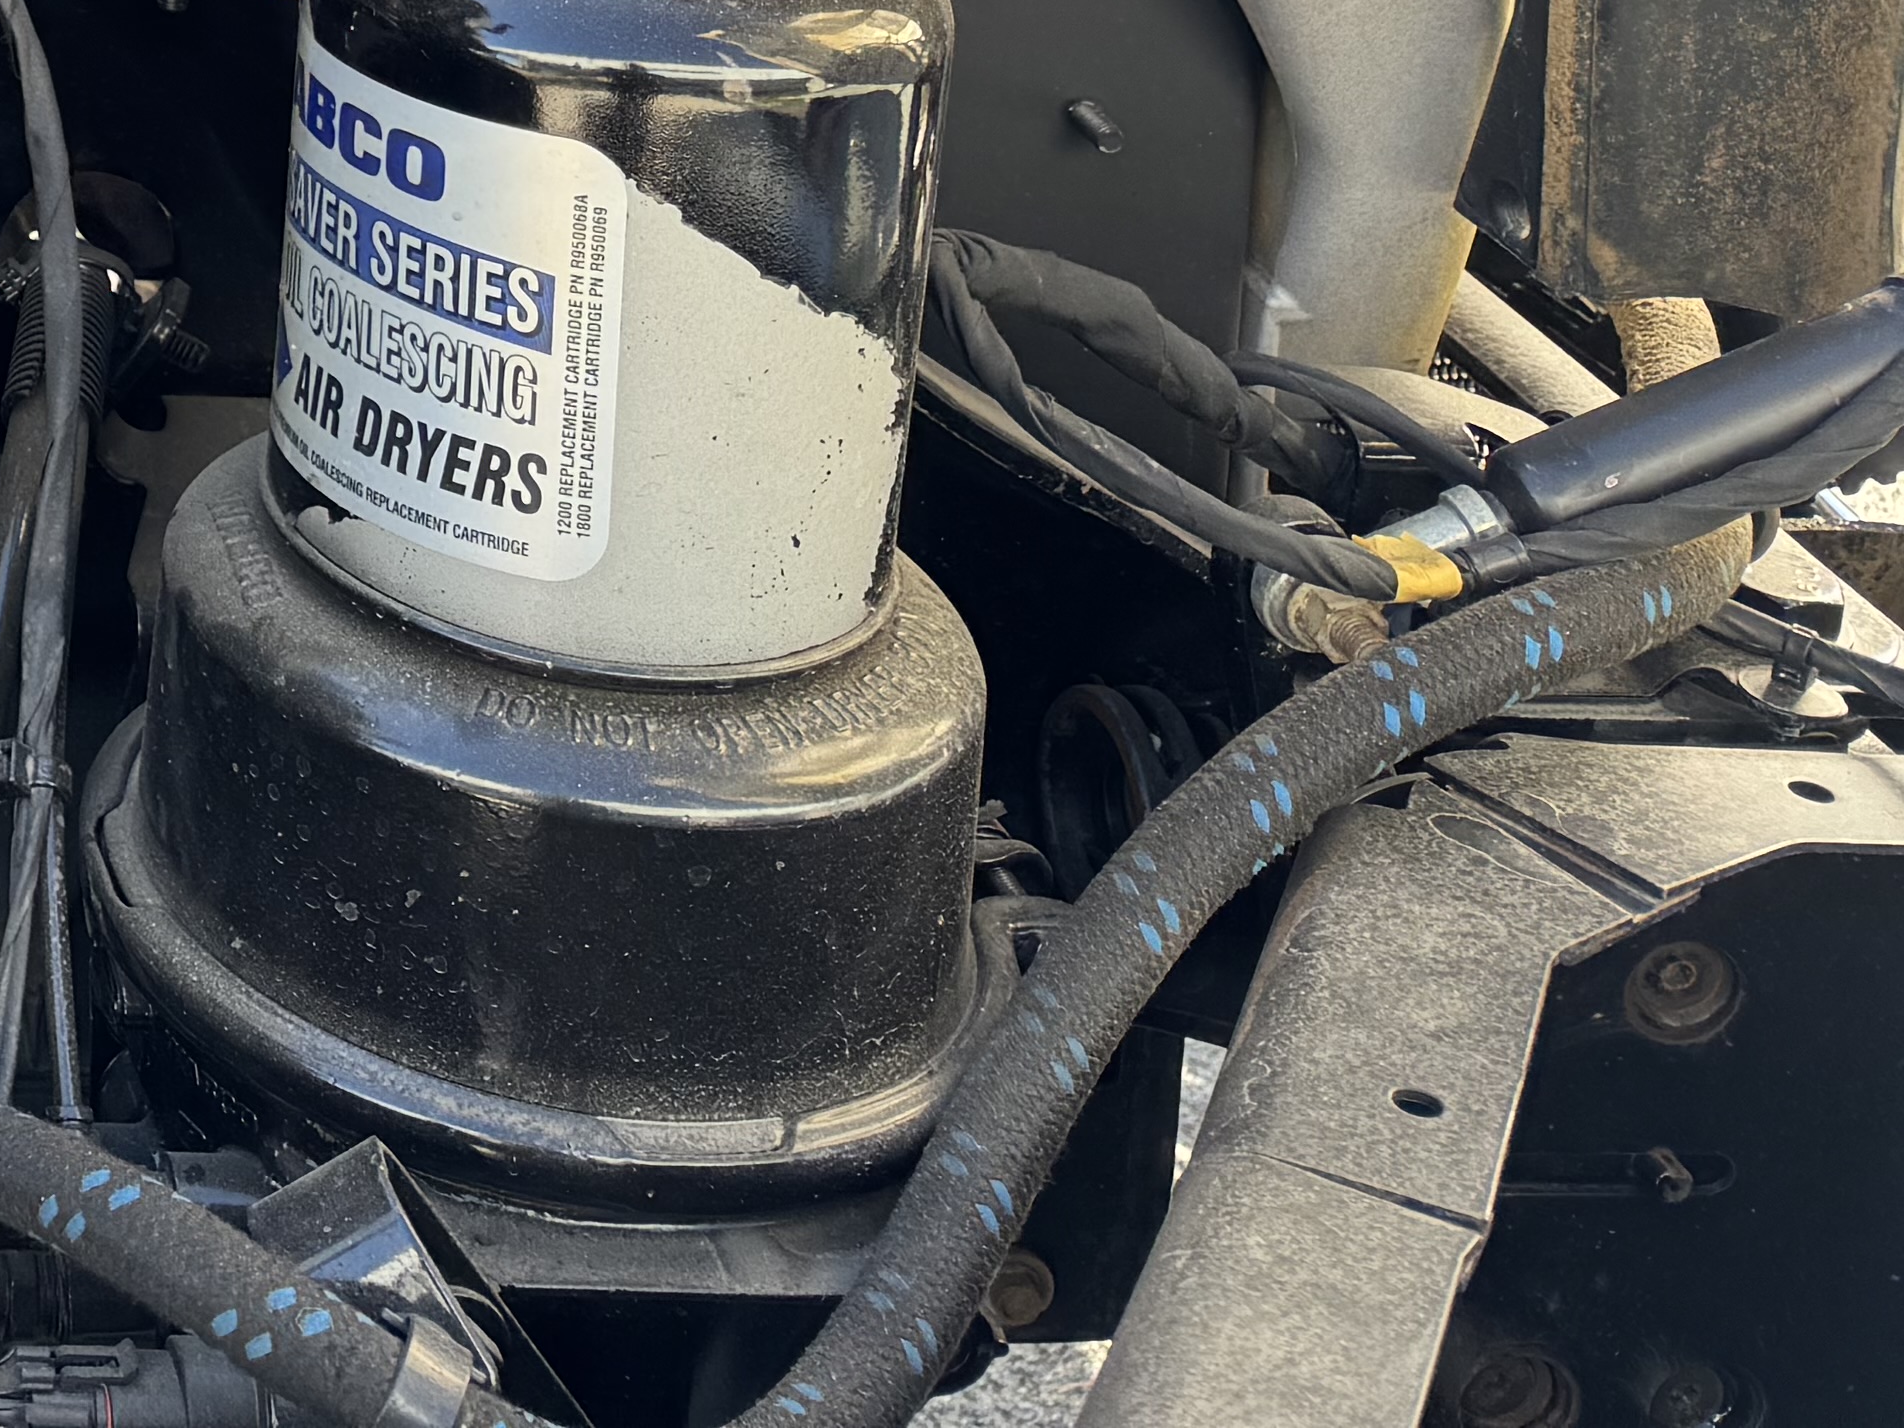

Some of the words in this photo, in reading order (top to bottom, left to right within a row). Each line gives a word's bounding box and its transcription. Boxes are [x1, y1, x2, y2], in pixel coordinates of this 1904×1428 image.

[571, 193, 589, 271] R950068A
[590, 206, 608, 273] R950069
[369, 219, 541, 335] SERIES
[569, 273, 585, 295] PN
[588, 275, 605, 299] PN
[307, 264, 538, 427] COALESCING
[565, 298, 584, 385] CARTRIDGE
[584, 301, 603, 387] CARTRIDGE
[294, 352, 344, 440] AIR
[353, 395, 548, 515] DRYERS
[558, 387, 580, 498] REPLACEMENT
[578, 390, 598, 501] REPLACEMENT
[310, 450, 363, 496] COALESCING
[365, 485, 449, 535] REPLACEMENT
[452, 523, 530, 558] CARTRIDGE
[556, 501, 573, 537] 1200
[576, 503, 592, 539] 1800
